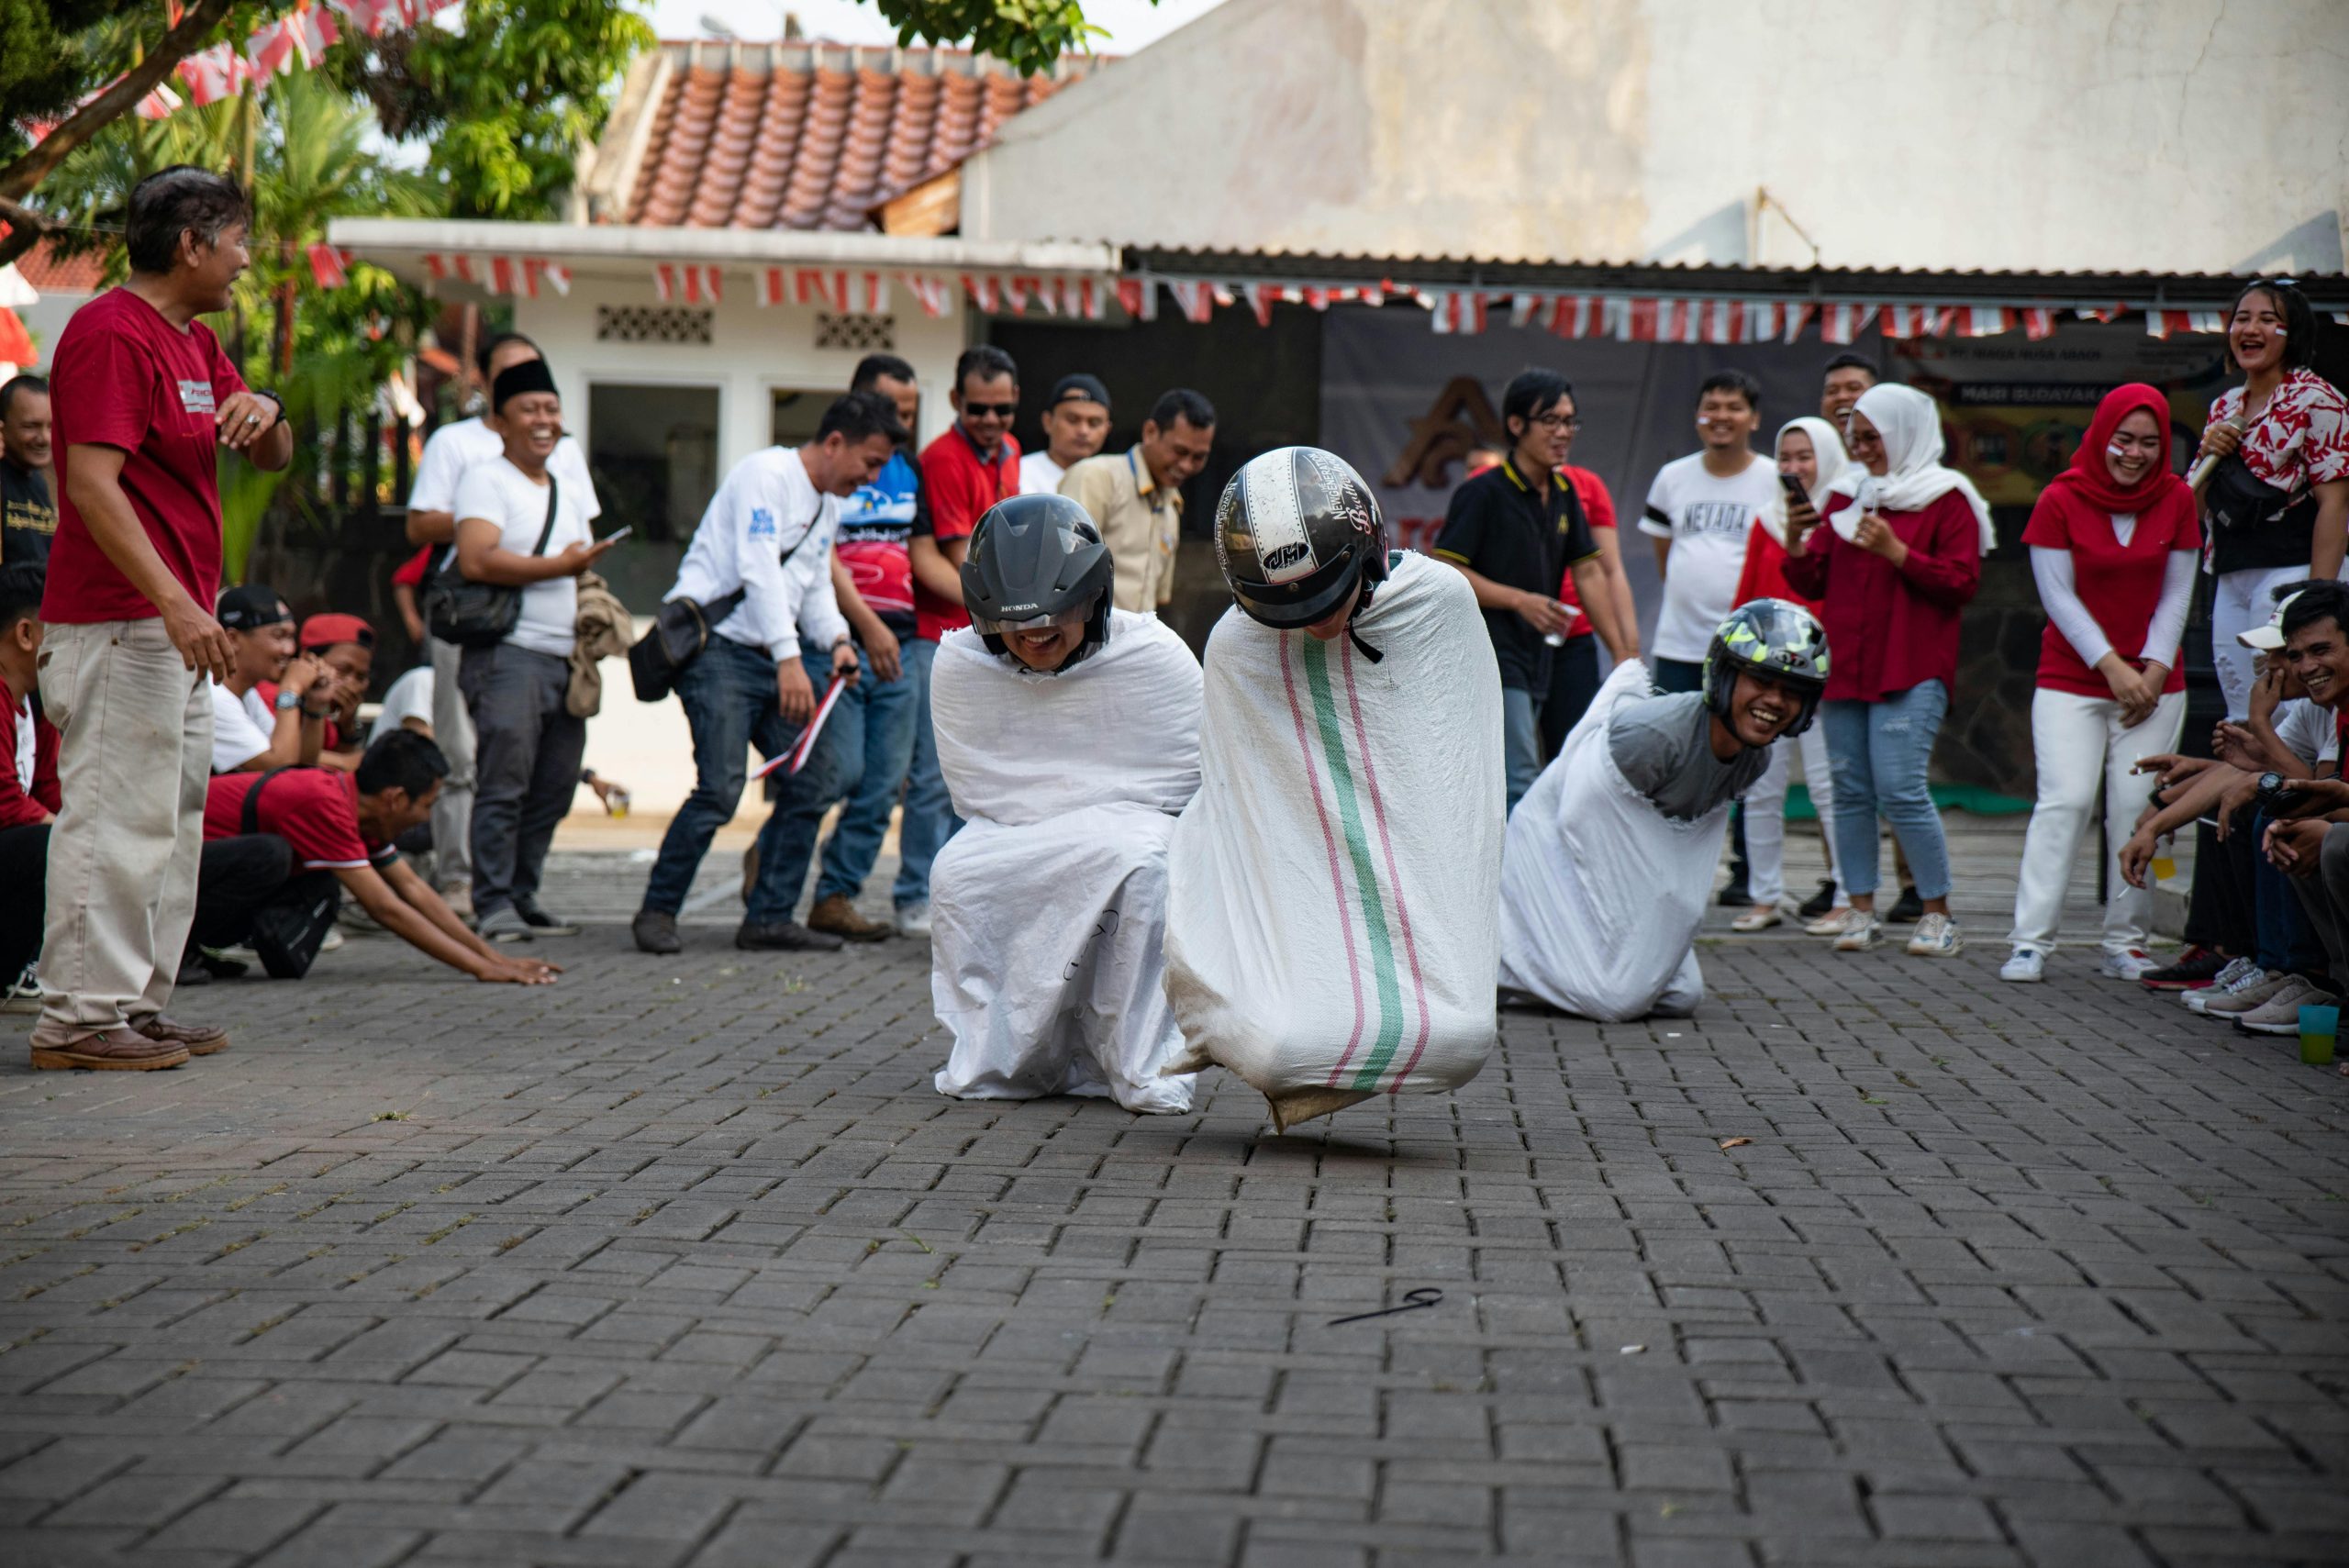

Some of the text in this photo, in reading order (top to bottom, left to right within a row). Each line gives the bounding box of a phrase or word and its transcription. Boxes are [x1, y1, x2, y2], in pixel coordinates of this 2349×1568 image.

[1962, 386, 2007, 401] MARI
[1683, 503, 1748, 533] NEVADA
[1001, 603, 1039, 612] HONDA
